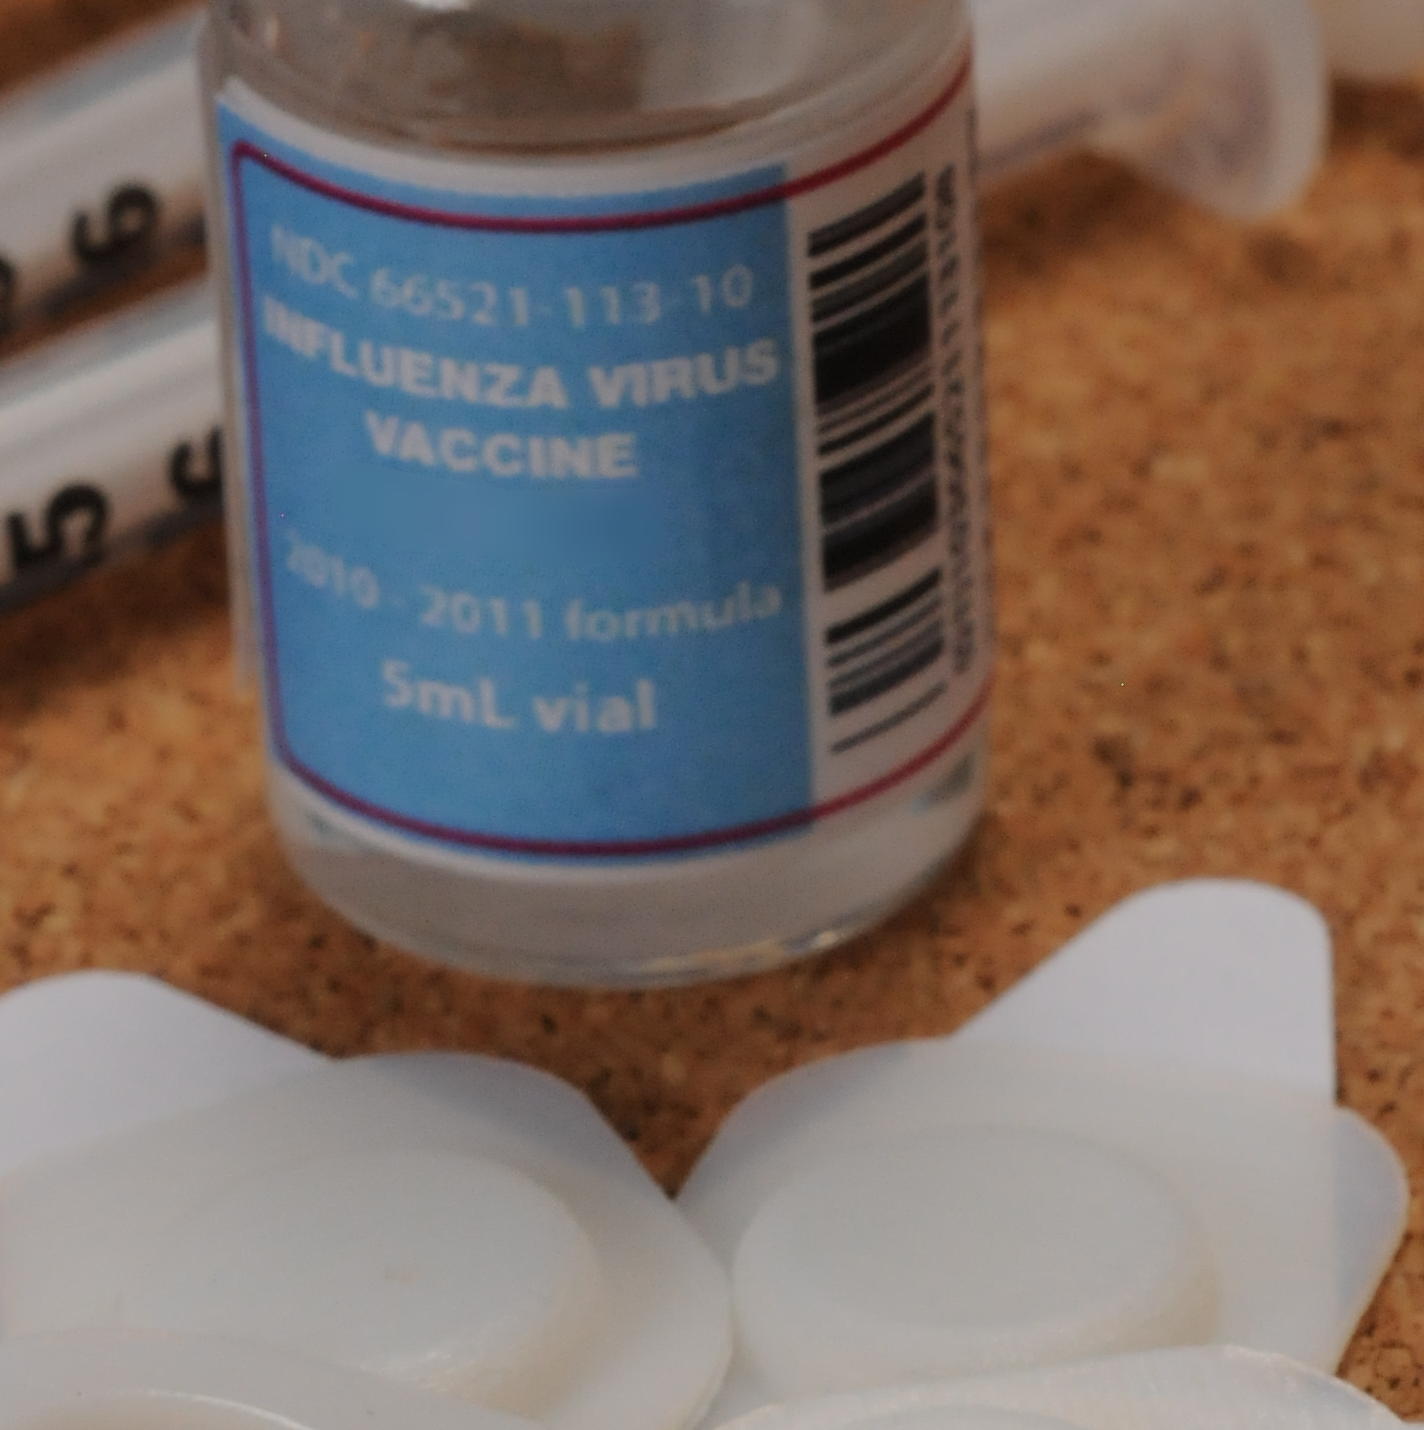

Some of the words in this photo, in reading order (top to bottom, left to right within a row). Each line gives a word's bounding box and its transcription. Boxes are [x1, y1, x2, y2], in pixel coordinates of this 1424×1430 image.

[271, 223, 359, 301] NDC
[263, 293, 570, 410] INFLUENZA
[589, 338, 779, 409] VIRUS
[364, 408, 639, 479] VACCINE
[6, 485, 108, 569] 5
[565, 580, 783, 642] formula
[382, 658, 517, 730] 5mL
[532, 676, 659, 734] vial
